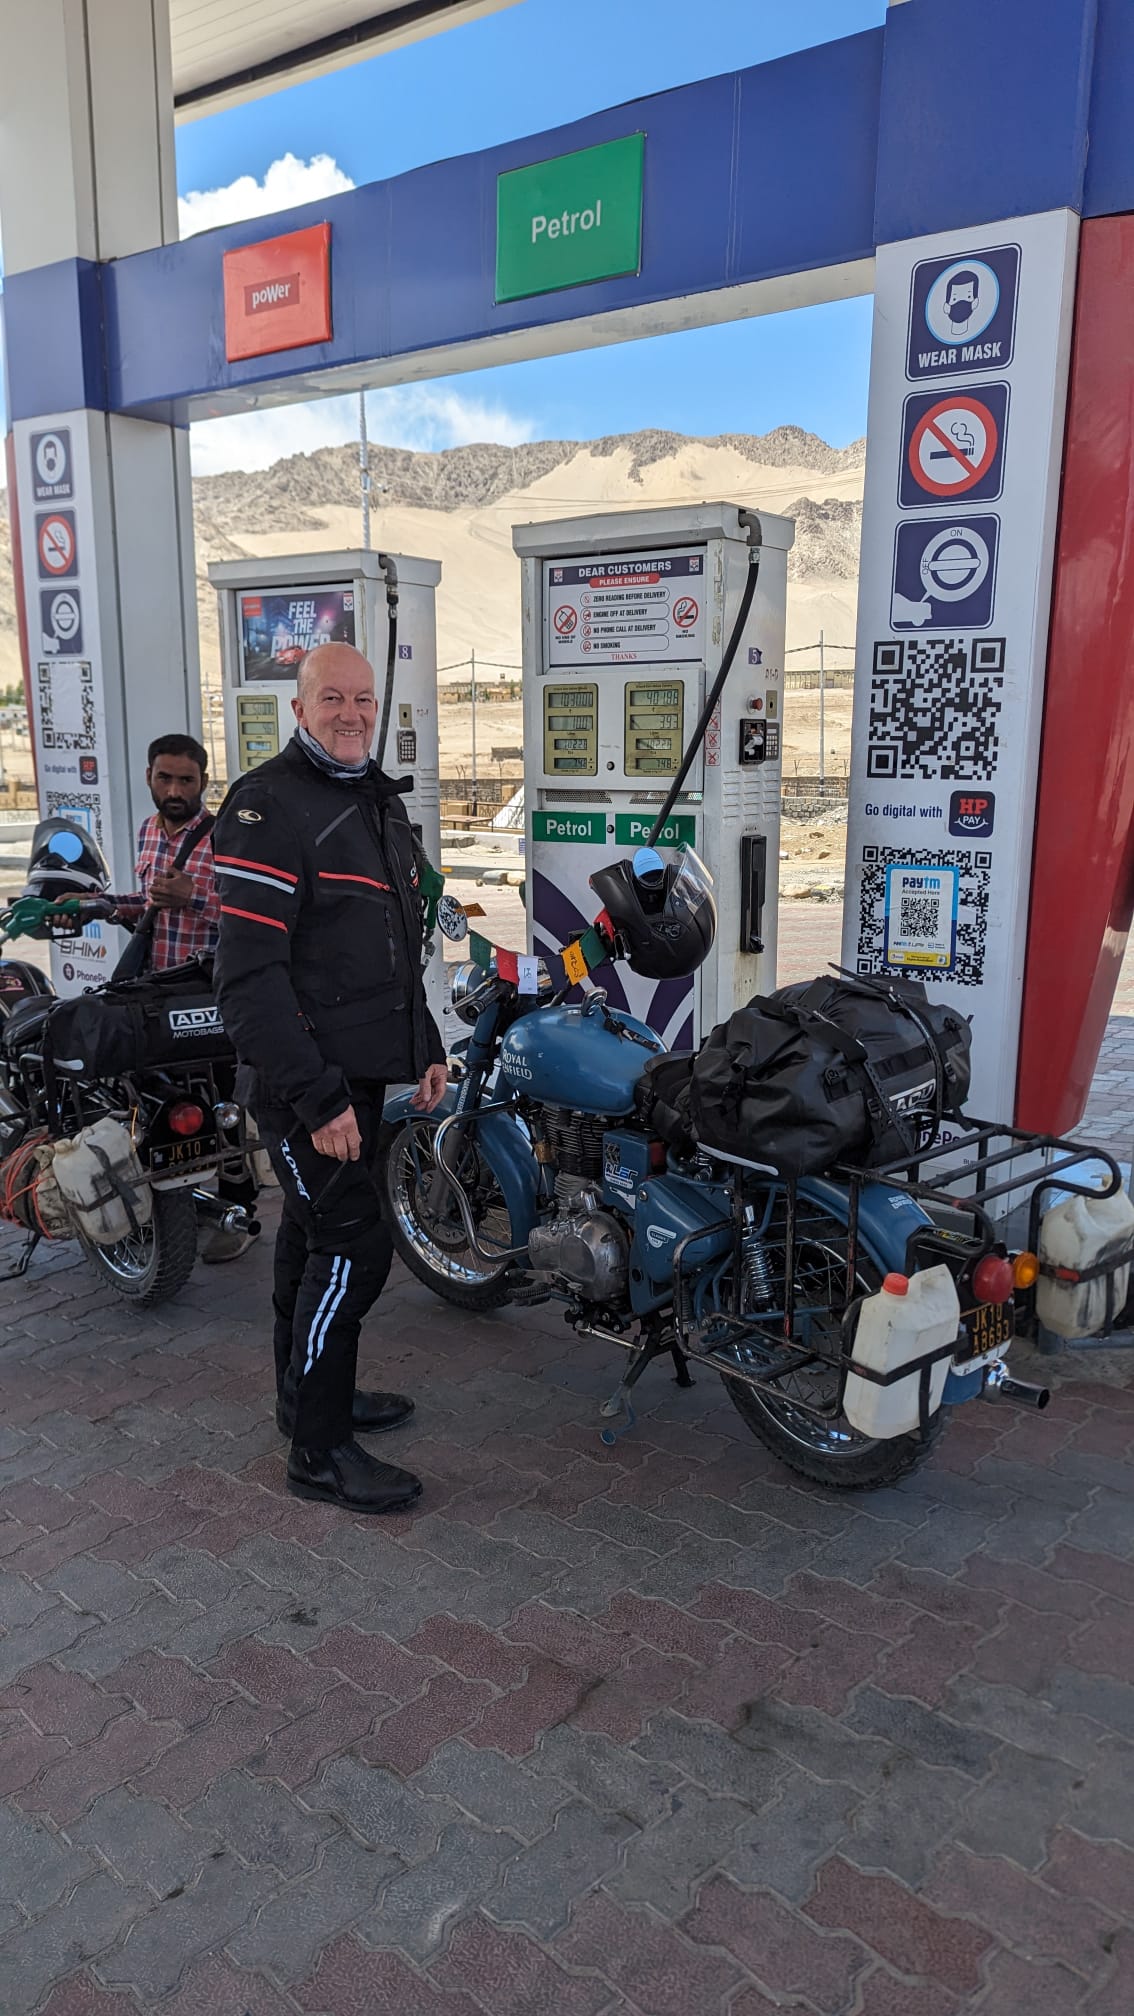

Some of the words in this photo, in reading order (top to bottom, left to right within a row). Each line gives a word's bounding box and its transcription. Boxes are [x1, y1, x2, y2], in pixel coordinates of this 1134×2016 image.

[531, 200, 601, 243] Petrol
[918, 349, 957, 369] WEAR
[961, 342, 1002, 363] MASK
[36, 485, 53, 498] WEAR
[54, 484, 71, 495] MASK
[950, 529, 963, 537] ON
[578, 566, 605, 577] DEAR
[607, 561, 672, 575] CUSTOMERS
[599, 578, 623, 586] PLEASE
[624, 576, 650, 584] ENSURE
[593, 595, 605, 603] ZERO
[605, 593, 625, 602] READING
[626, 592, 643, 600] BEFORE
[644, 590, 666, 599] DELIVERY
[288, 600, 317, 620] FEEL
[593, 610, 609, 618] ENGINE
[610, 609, 619, 617] OFF
[619, 609, 626, 617] AT
[627, 608, 648, 616] DELIVERY
[293, 618, 314, 634] THE
[593, 626, 600, 634] NO
[600, 625, 615, 633] PHONE
[615, 625, 627, 633] CALL
[634, 624, 656, 632] DELIVERY
[402, 647, 409, 659] 8
[600, 641, 621, 649] SMOKING
[611, 653, 637, 661] THANKS
[751, 649, 759, 664] 5
[865, 803, 879, 816] Go
[883, 804, 916, 819] digital
[920, 805, 943, 818] with
[959, 798, 989, 815] HP
[546, 819, 592, 837] Petrol
[962, 816, 981, 825] PAY
[630, 821, 679, 840] Perol
[60, 940, 101, 959] BHIM
[176, 1010, 218, 1027] ADV
[173, 1026, 225, 1039] MOTOBAGS
[502, 1048, 528, 1067] ROYAL
[169, 1141, 201, 1161] JK10
